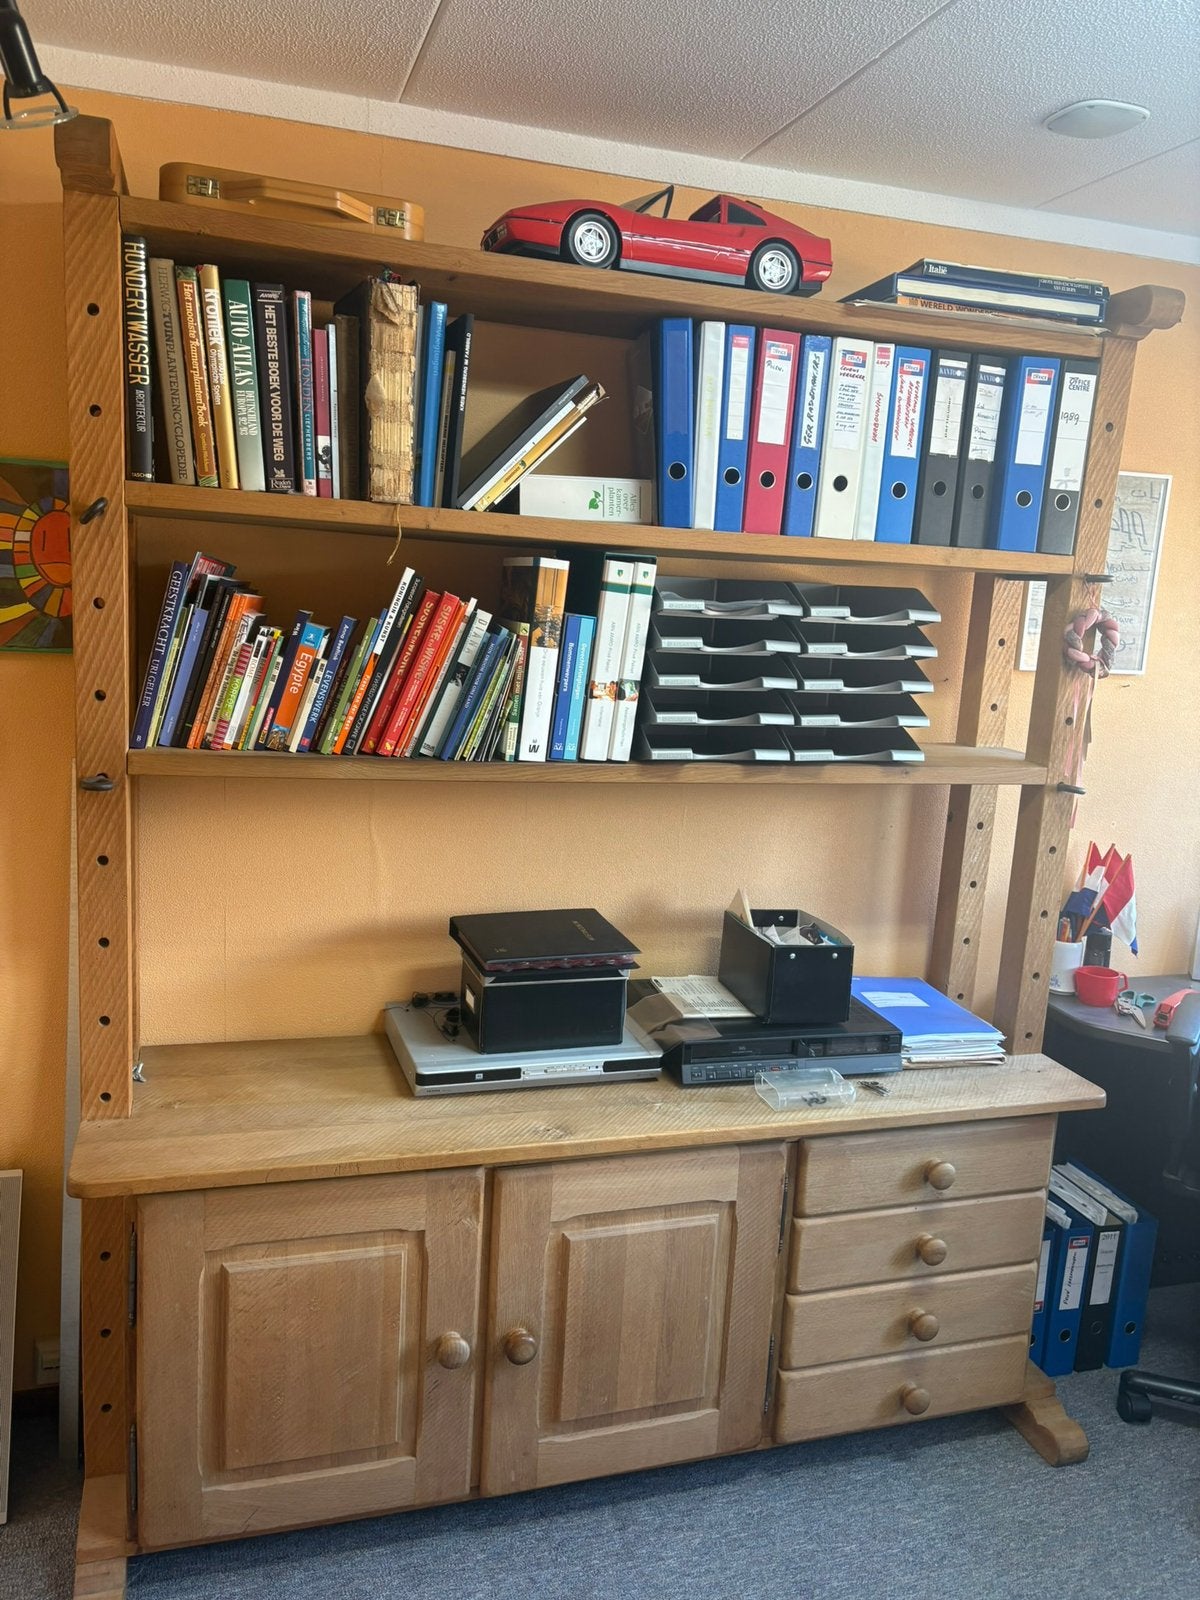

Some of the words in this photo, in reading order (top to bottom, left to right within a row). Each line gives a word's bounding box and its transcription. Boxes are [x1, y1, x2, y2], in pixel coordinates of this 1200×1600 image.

[184, 282, 193, 300] Het
[920, 299, 954, 311] WERELD
[124, 242, 150, 386] HUNDERTWASSER
[185, 301, 198, 338] mooiste
[204, 288, 224, 346] Kroniek
[264, 305, 276, 326] HET
[229, 300, 254, 386] AUTO-ATLAS
[266, 328, 278, 360] BESTE
[208, 348, 221, 383] Olympische
[268, 362, 280, 390] BOEK
[213, 384, 224, 405] Spelen
[302, 358, 312, 412] HONDEN
[136, 390, 146, 432] ARCHITEKTUR
[236, 390, 246, 416] EUROPA
[246, 390, 258, 436] DEUTSCHLAND
[270, 391, 282, 421] VOOR
[1060, 412, 1080, 426] 1989
[272, 423, 282, 436] DE
[804, 426, 814, 445] GER
[273, 438, 284, 461] WEG
[156, 570, 183, 654] GEESTKRACHT
[390, 581, 407, 614] KONINGIN
[339, 624, 349, 639] Anna
[378, 620, 391, 642] KUNST
[429, 603, 454, 641] SUSKE
[464, 618, 488, 656] DIANA
[149, 658, 159, 674] URI
[246, 658, 256, 678] ROME
[290, 652, 312, 694] Egypte
[413, 646, 435, 681] WISKE
[473, 672, 482, 685] VOOR
[478, 654, 490, 672] DROOM
[562, 642, 574, 692] Bommenwerpers
[140, 674, 156, 707] GELLER
[224, 677, 242, 710] KORFOE
[308, 669, 333, 723] LEVENSWERK
[463, 694, 472, 708] LAND
[512, 696, 520, 717] Samen
[516, 666, 524, 684] mijn
